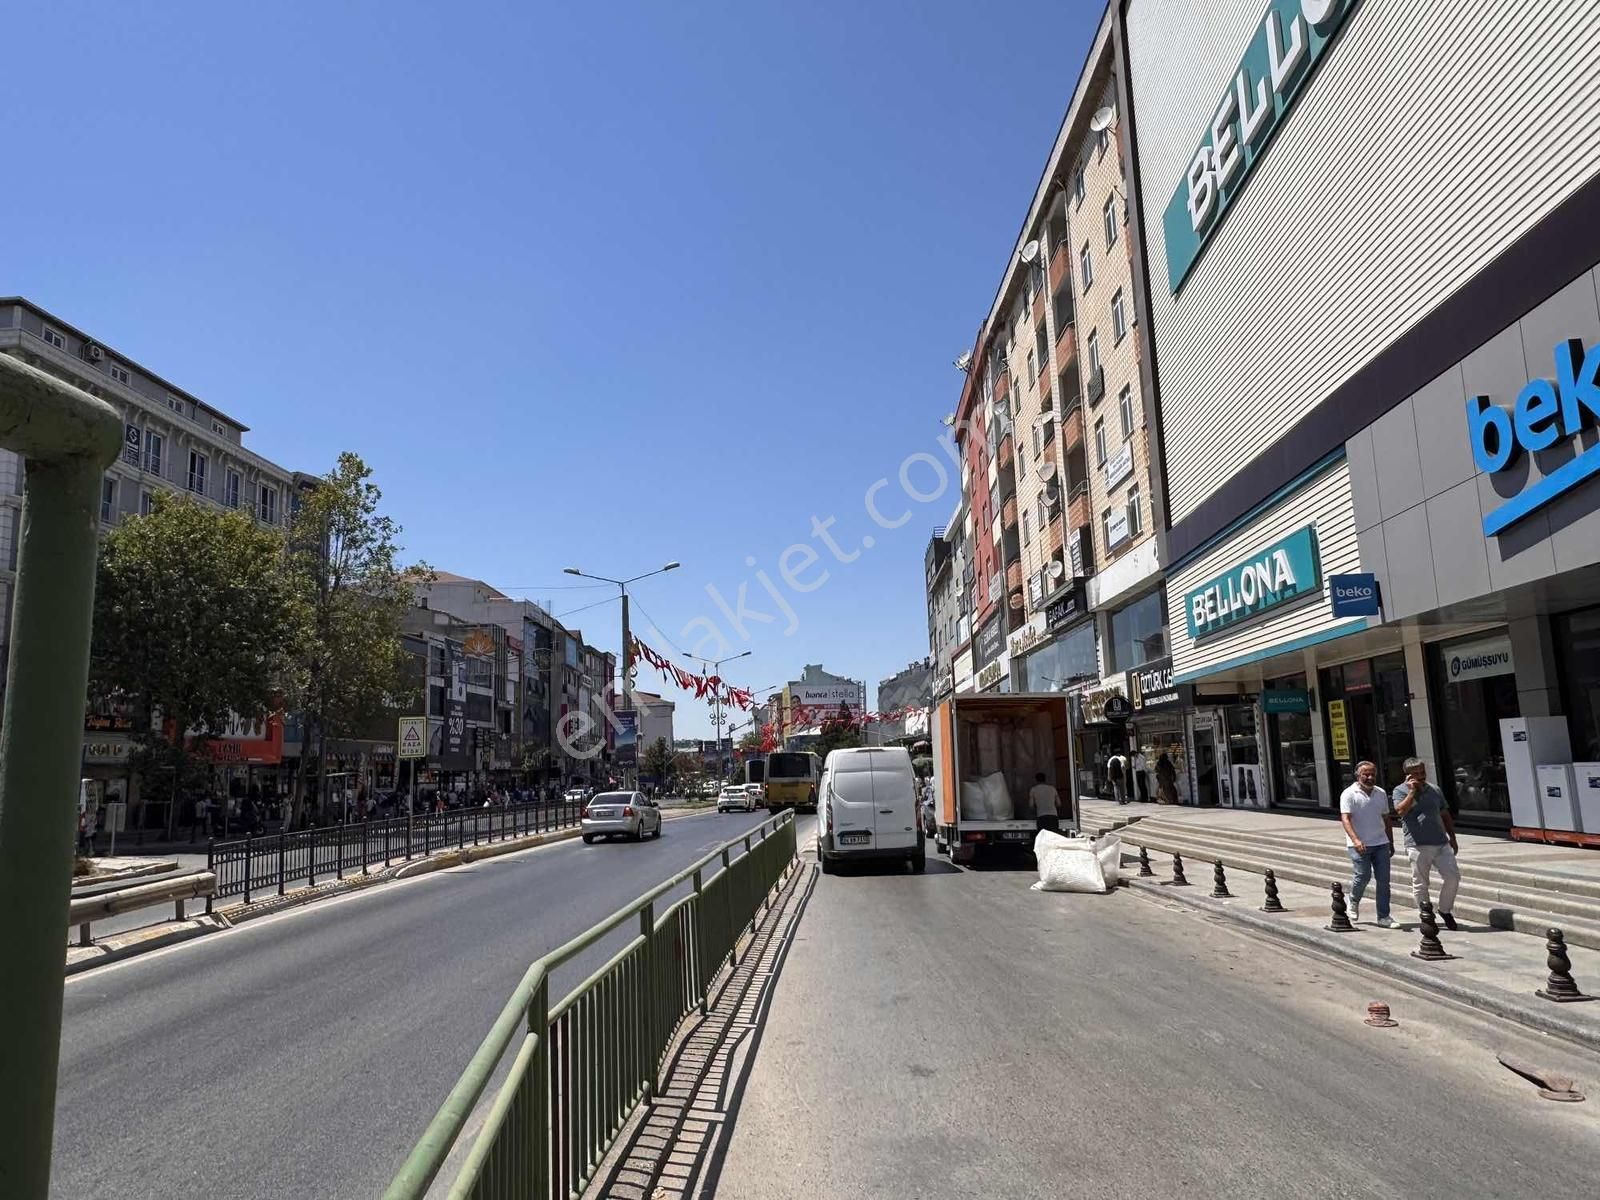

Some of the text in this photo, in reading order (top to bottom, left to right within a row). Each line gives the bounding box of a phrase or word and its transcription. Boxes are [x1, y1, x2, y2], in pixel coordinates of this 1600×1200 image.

[1192, 549, 1296, 627] BELLONA
[1336, 586, 1372, 597] beko
[1461, 652, 1509, 670] GÜMÜŞSUYU
[1140, 668, 1163, 693] ÖZTÜRK
